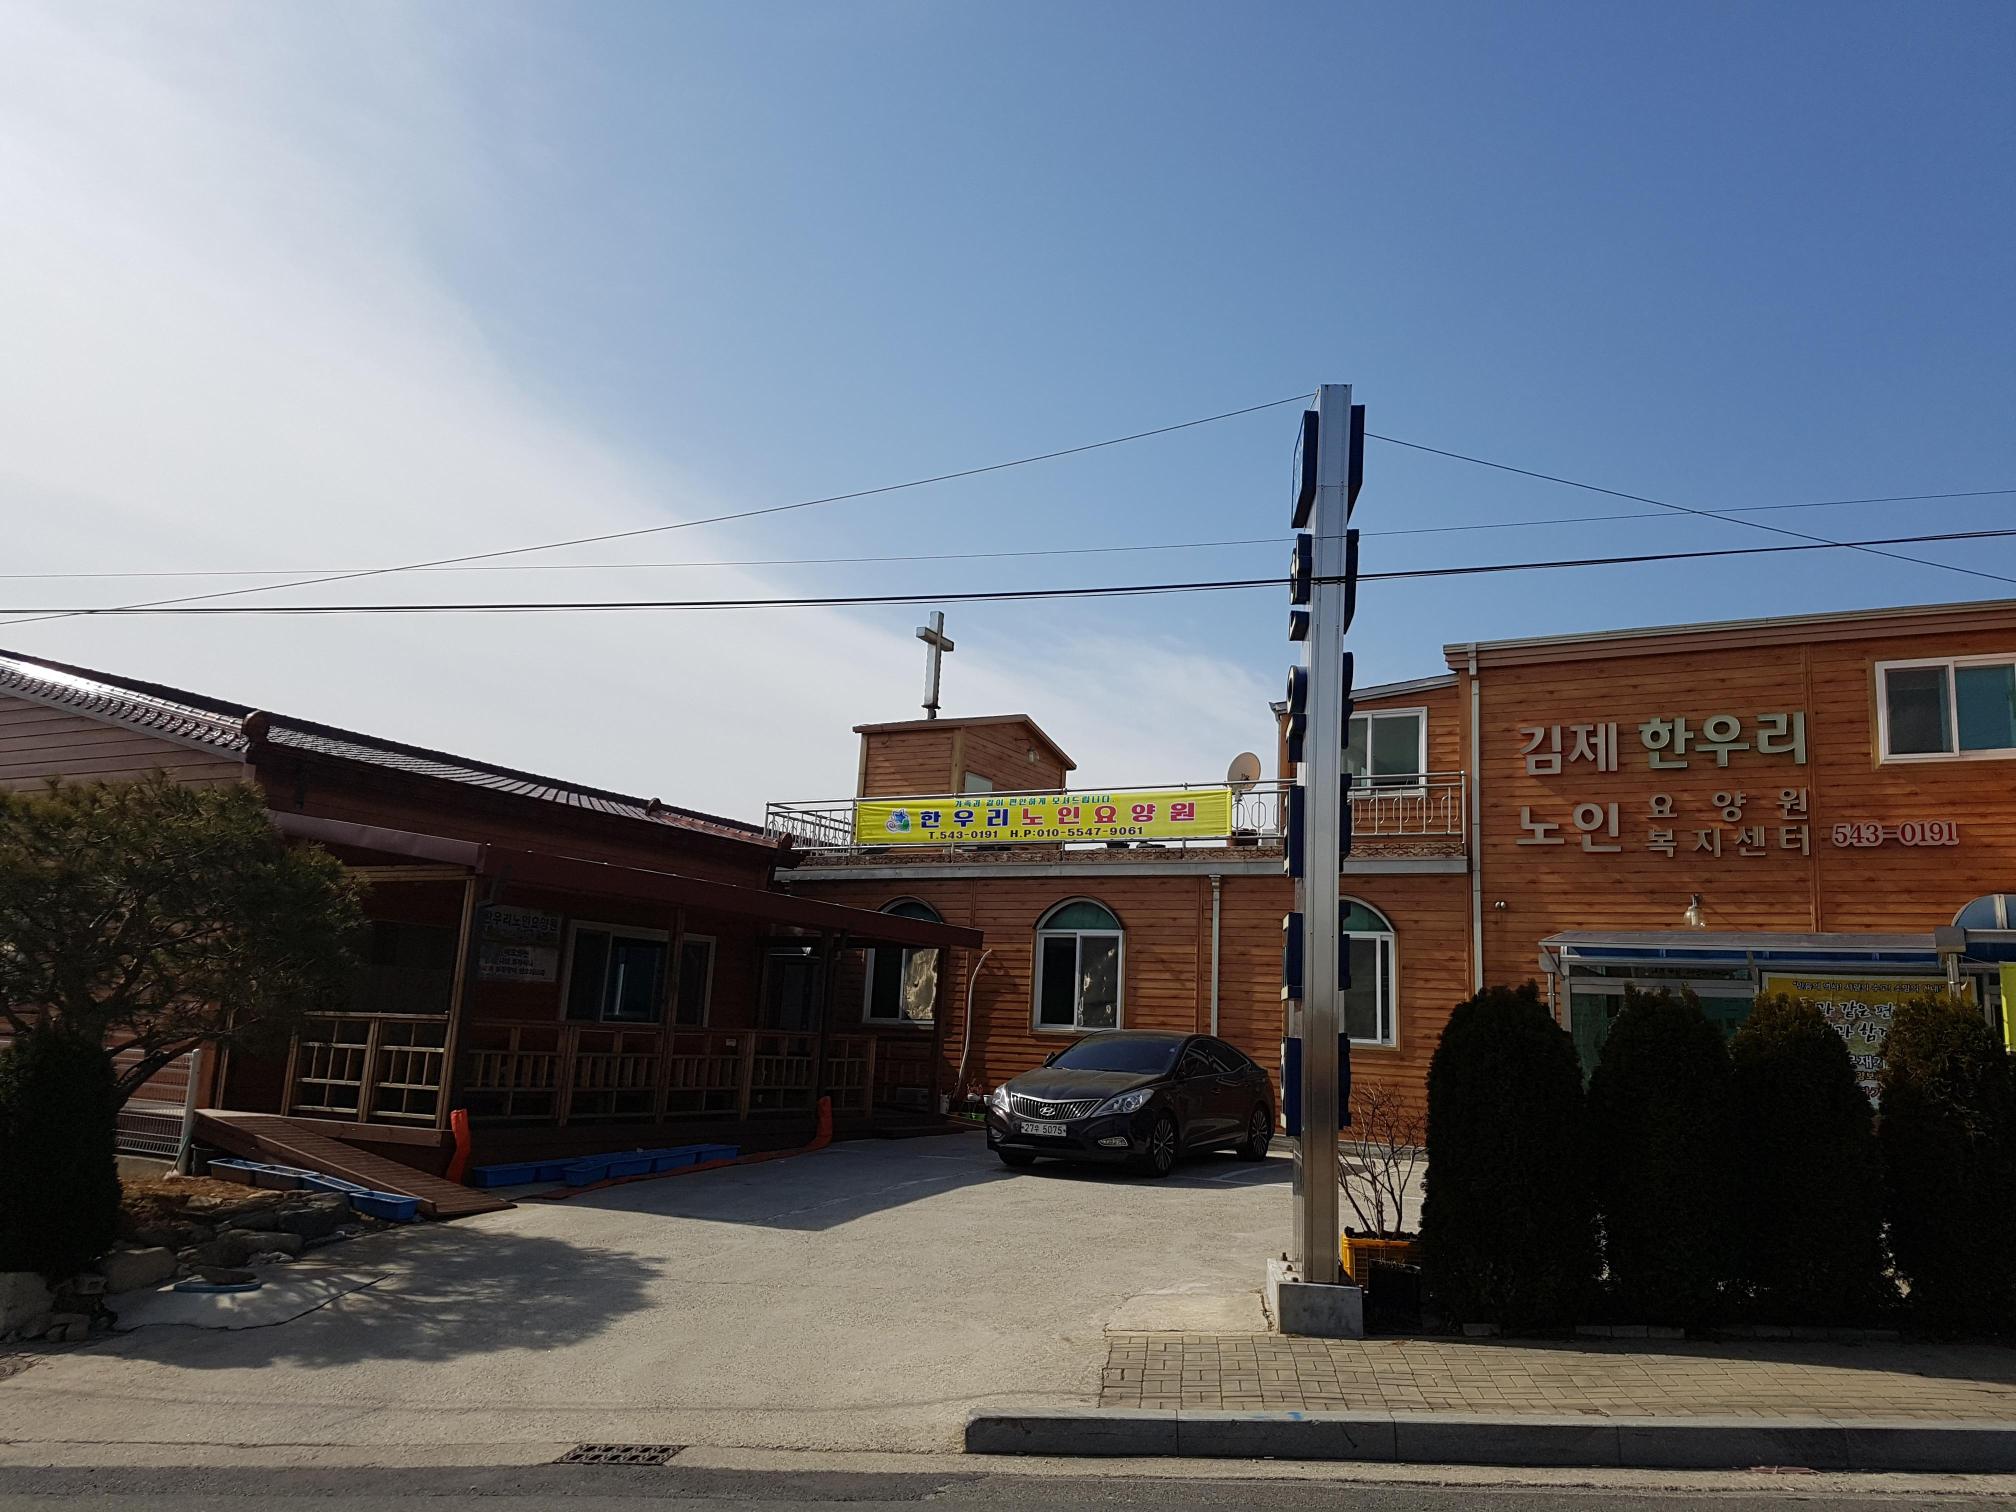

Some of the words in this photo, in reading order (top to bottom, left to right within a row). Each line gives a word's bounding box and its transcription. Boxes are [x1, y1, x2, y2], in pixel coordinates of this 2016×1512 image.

[1519, 722, 1618, 776] 김제
[1638, 711, 1807, 769] 한우리
[920, 808, 1010, 829] 한우리
[1646, 787, 1808, 823] 요양원
[929, 829, 999, 840] T.543-0191
[1515, 802, 1622, 853] 노인
[1645, 824, 1810, 858] 복지센터
[1831, 820, 1960, 848] 543-0191
[1839, 1000, 1871, 1019] 같은
[1042, 1125, 1063, 1135] 5075
